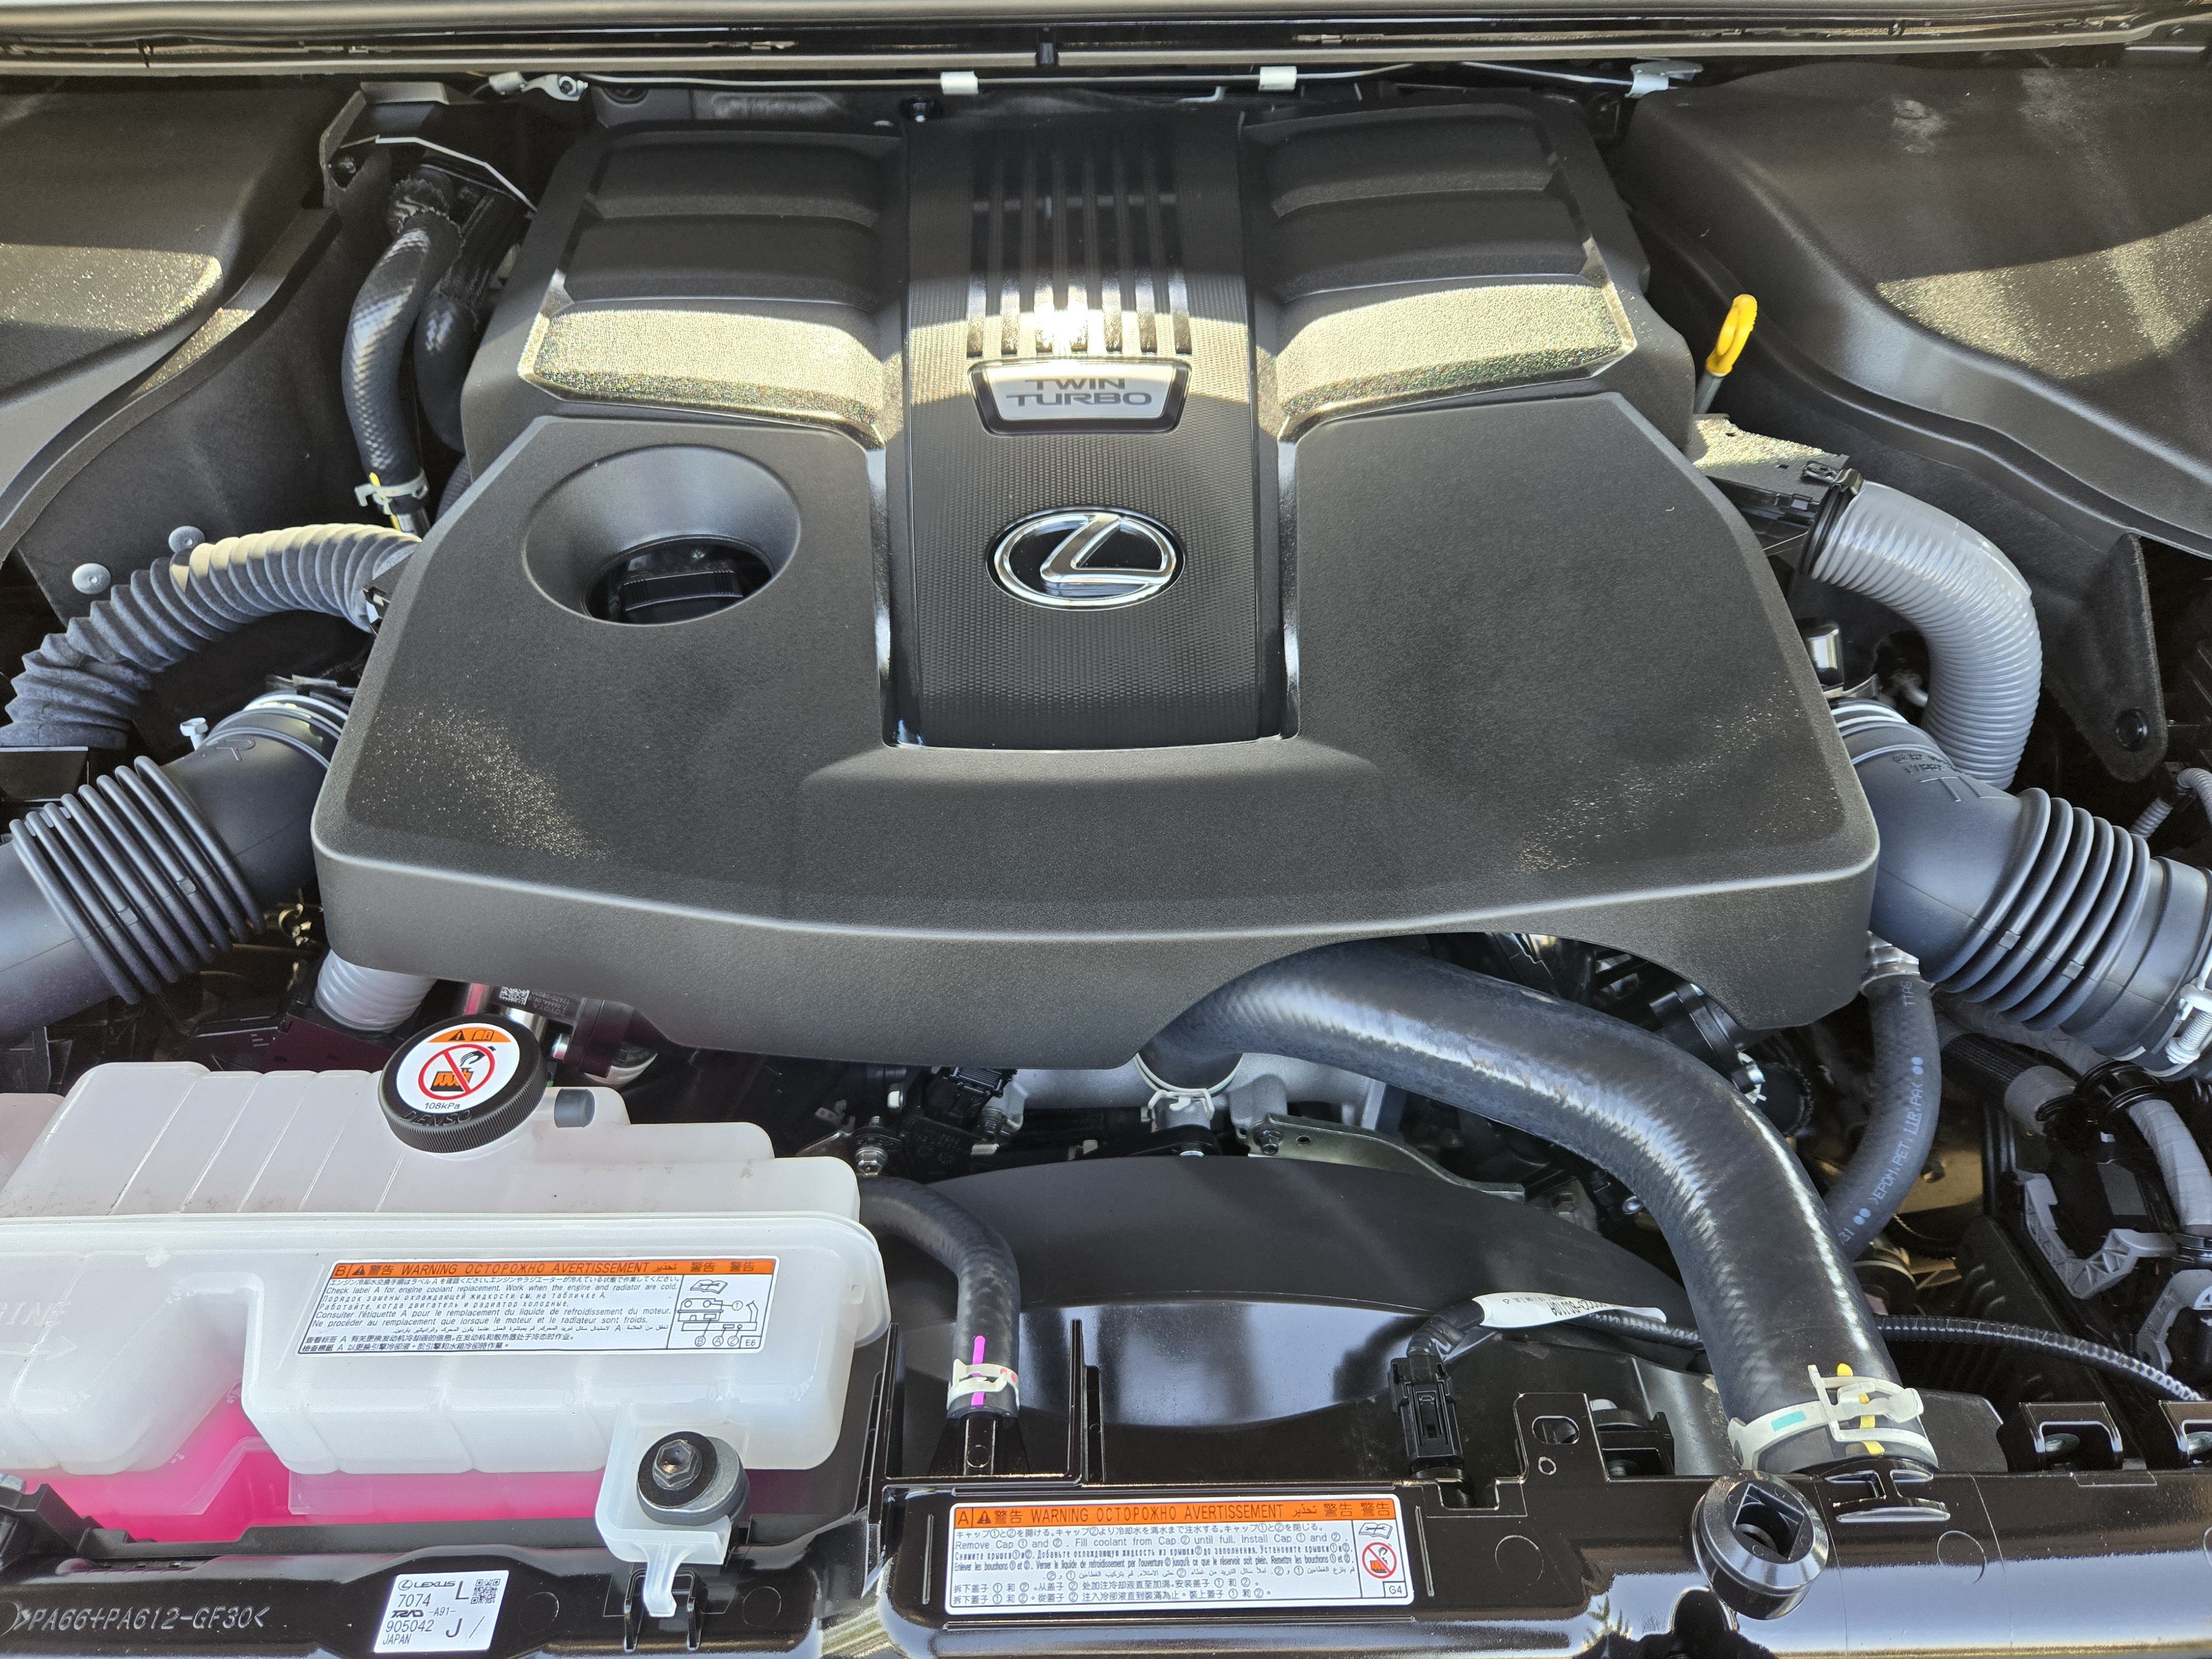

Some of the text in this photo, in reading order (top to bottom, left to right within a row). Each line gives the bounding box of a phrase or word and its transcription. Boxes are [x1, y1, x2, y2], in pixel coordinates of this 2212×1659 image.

[1025, 378, 1125, 390] TWIN
[1006, 392, 1151, 406] TURBO
[400, 1109, 472, 1126] DENSO
[334, 1265, 348, 1276] B
[366, 1264, 396, 1275] 警告
[400, 1264, 458, 1275] WARNING
[463, 1263, 546, 1274] ОСТОРОЖНО
[551, 1262, 649, 1274] AVERTISSEMENT
[689, 1261, 716, 1272] 警告
[729, 1261, 755, 1272] 警告
[456, 1285, 500, 1293] replacement.
[565, 1284, 591, 1292] engine
[594, 1284, 609, 1292] and
[404, 1292, 466, 1301] охлаждающей
[319, 1302, 371, 1310] Работайте,
[316, 1311, 354, 1319] Consulter
[358, 1310, 396, 1318] l'étiquette
[446, 1308, 500, 1318] remplacement
[519, 1308, 545, 1316] liquide
[549, 1308, 559, 1317] de
[564, 1308, 623, 1317] refroidissement
[641, 1307, 671, 1316] moteur.
[327, 1318, 363, 1327] procéder
[382, 1318, 436, 1326] remplacement
[493, 1317, 500, 1326] le
[560, 1316, 597, 1325] radiateur
[957, 1511, 969, 1525] A
[994, 1510, 1022, 1524] 警告
[1031, 1508, 1088, 1523] WARNING
[1096, 1506, 1177, 1521] ОСТОРОЖНО
[1183, 1504, 1284, 1520] AVERTISSEMENT
[1323, 1503, 1353, 1517] 警告
[1360, 1502, 1390, 1516] 警告
[954, 1541, 989, 1550] Remove
[995, 1540, 1013, 1549] Cap
[1031, 1538, 1048, 1548] and
[1075, 1537, 1089, 1547] Fill
[1093, 1537, 1126, 1546] coolant
[1133, 1536, 1152, 1546] from
[1194, 1535, 1213, 1545] until
[1219, 1535, 1235, 1543] full.
[1241, 1534, 1267, 1543] Install
[1274, 1533, 1292, 1543] Cap
[1310, 1532, 1327, 1542] and
[455, 1580, 469, 1600] L
[1389, 1586, 1402, 1594] G4
[398, 1593, 432, 1608] 7074
[429, 1606, 456, 1616] -A91-
[385, 1618, 463, 1638] 905042 J
[383, 1634, 411, 1645] JAPAN
